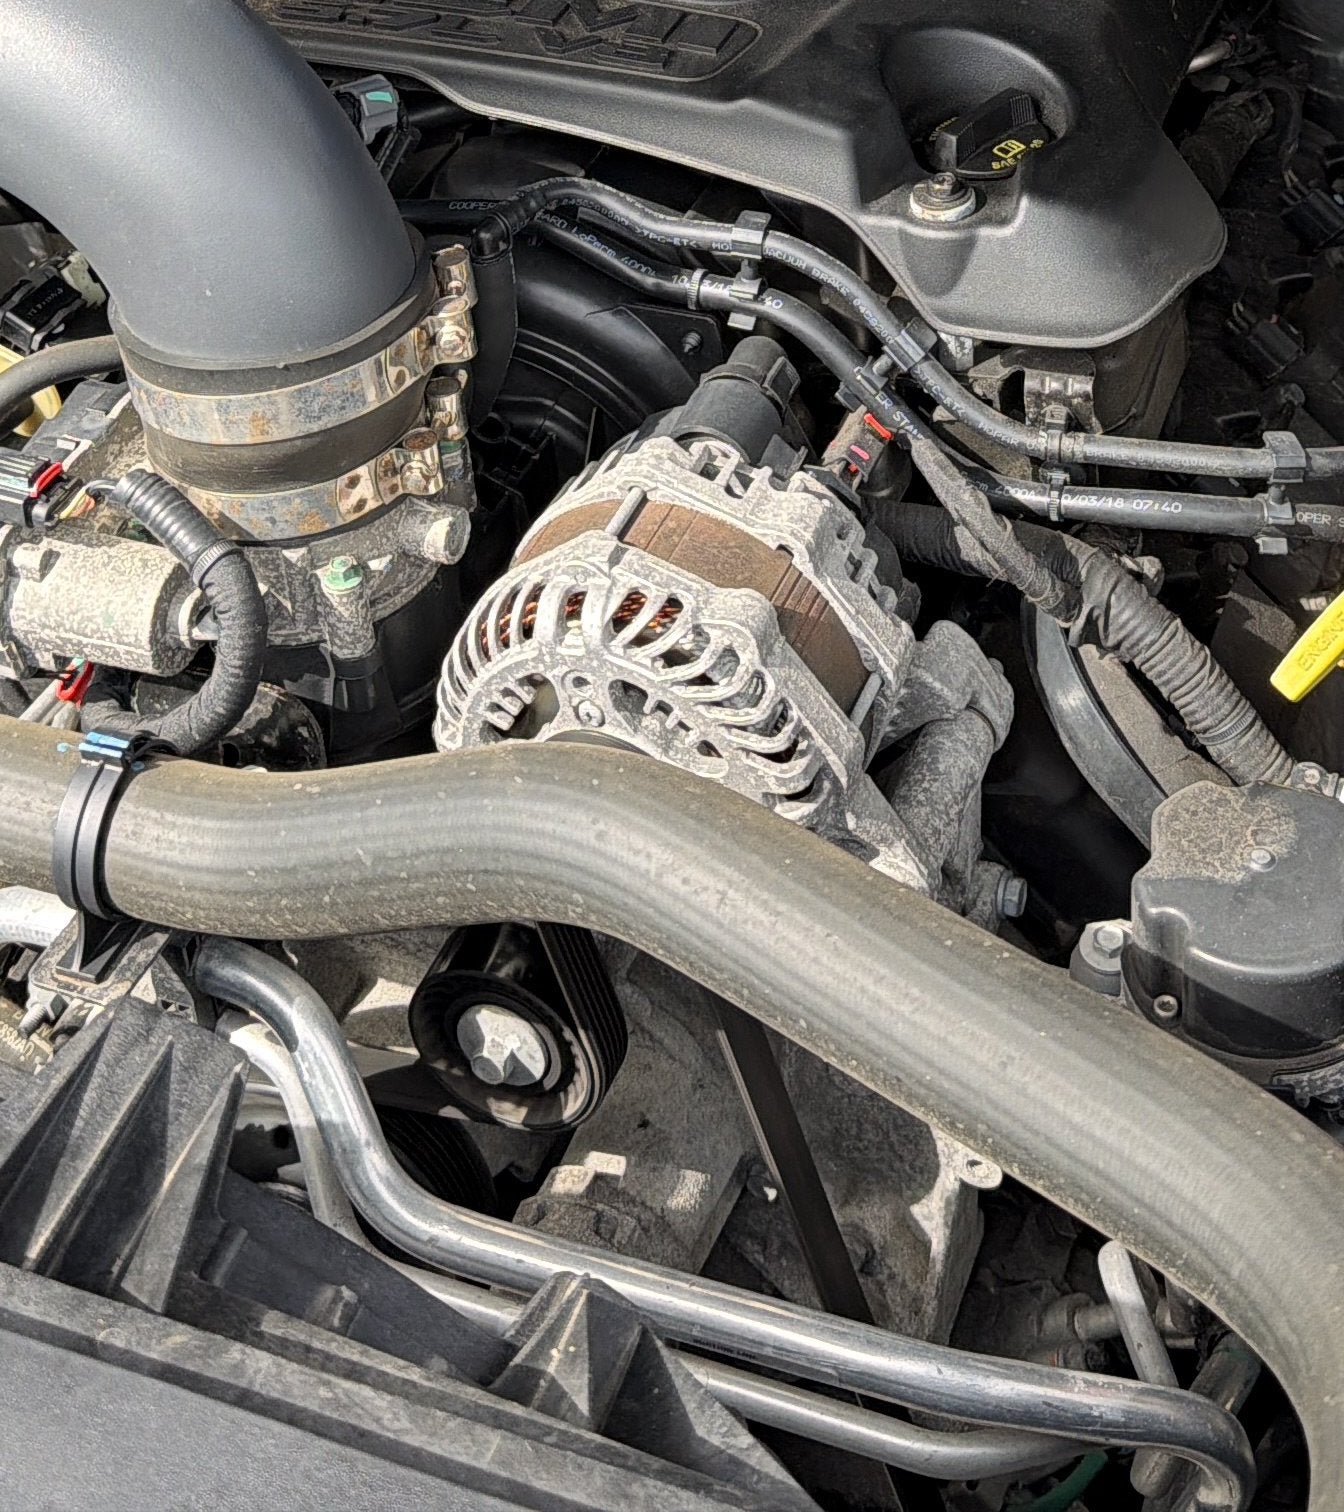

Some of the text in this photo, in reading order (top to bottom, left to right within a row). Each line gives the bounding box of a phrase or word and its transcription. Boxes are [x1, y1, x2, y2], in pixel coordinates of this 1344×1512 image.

[810, 266, 852, 297] BRAKE
[1059, 492, 1125, 510] 0/03/18
[1131, 497, 1184, 515] 07:40
[1295, 510, 1332, 527] OPER
